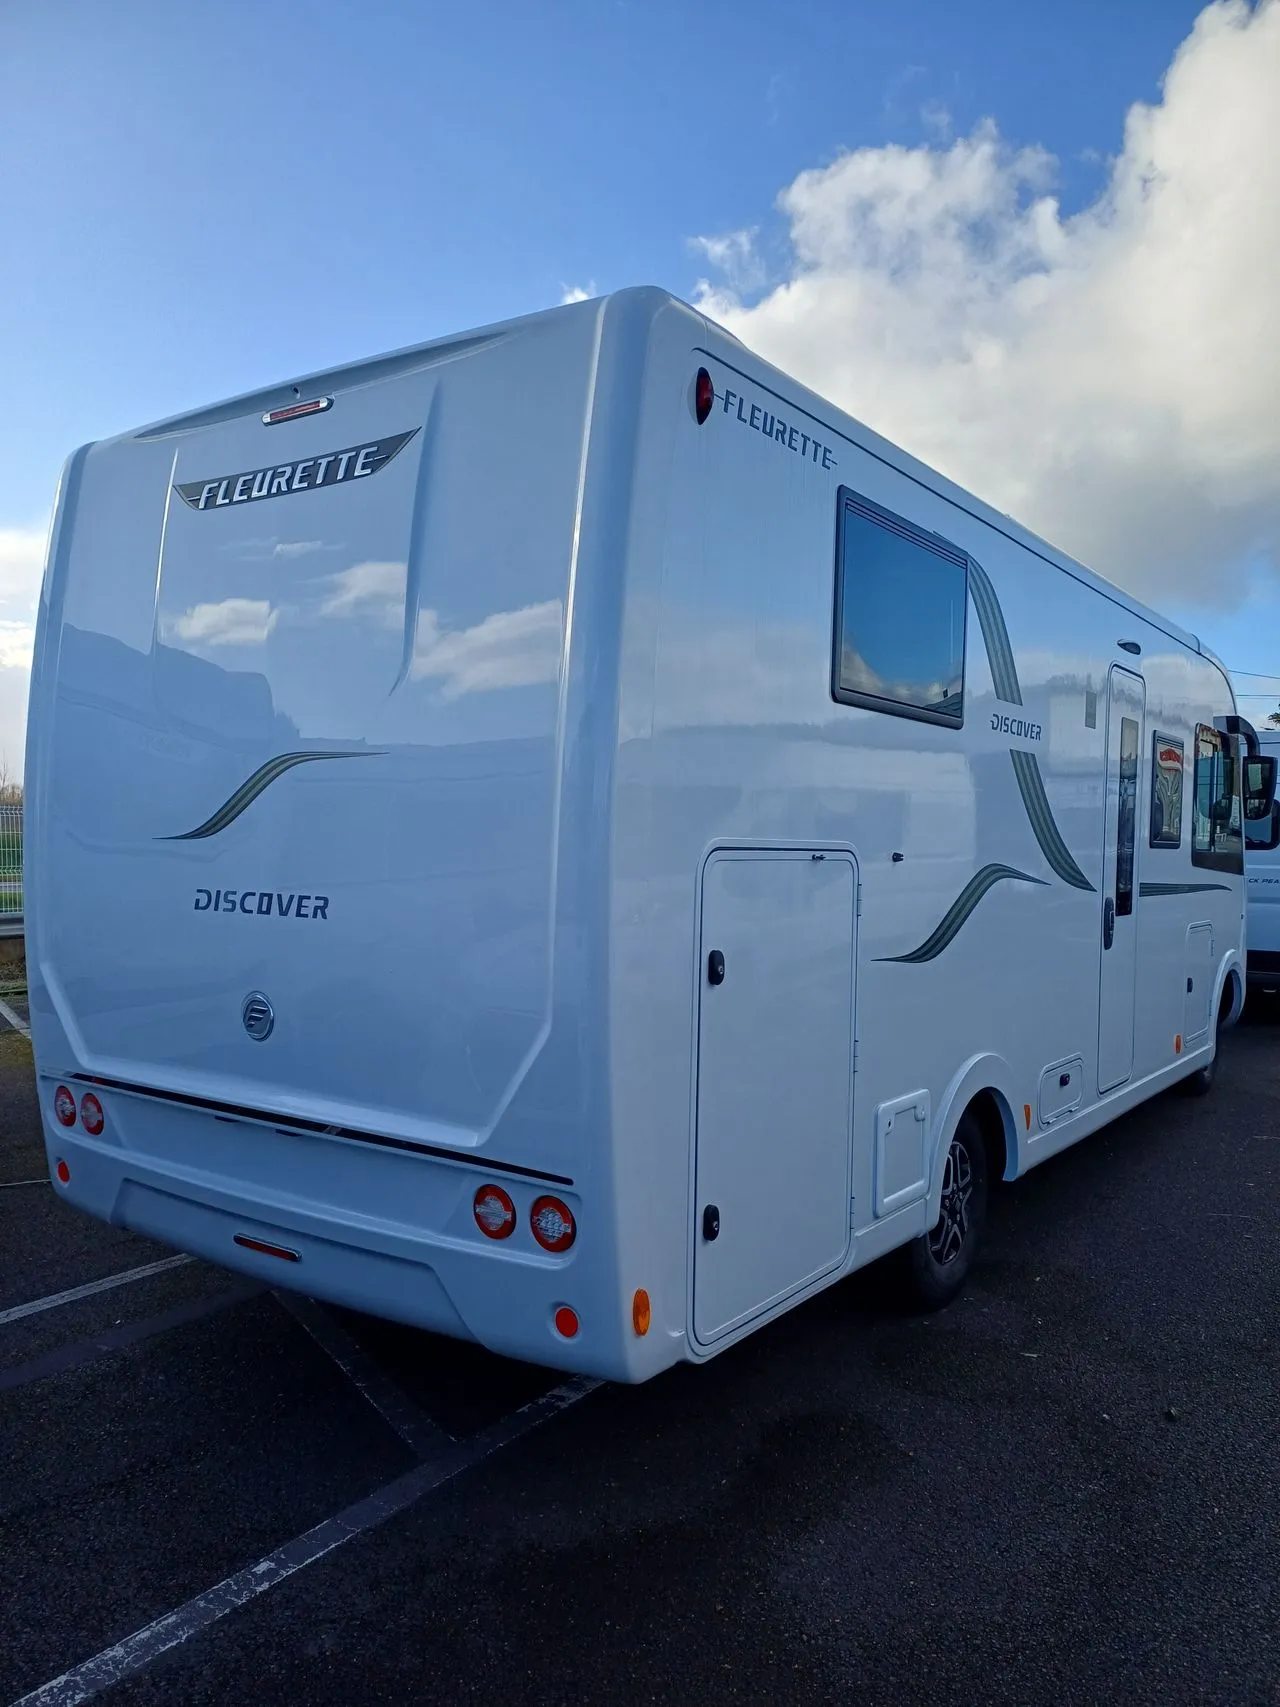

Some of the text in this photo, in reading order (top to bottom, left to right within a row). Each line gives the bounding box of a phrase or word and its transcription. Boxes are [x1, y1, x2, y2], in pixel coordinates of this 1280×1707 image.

[724, 389, 834, 470] FLEURETTE
[199, 446, 380, 509] FLEURETTE
[990, 713, 1042, 741] DISCOVER
[194, 888, 329, 919] DISCOVER
